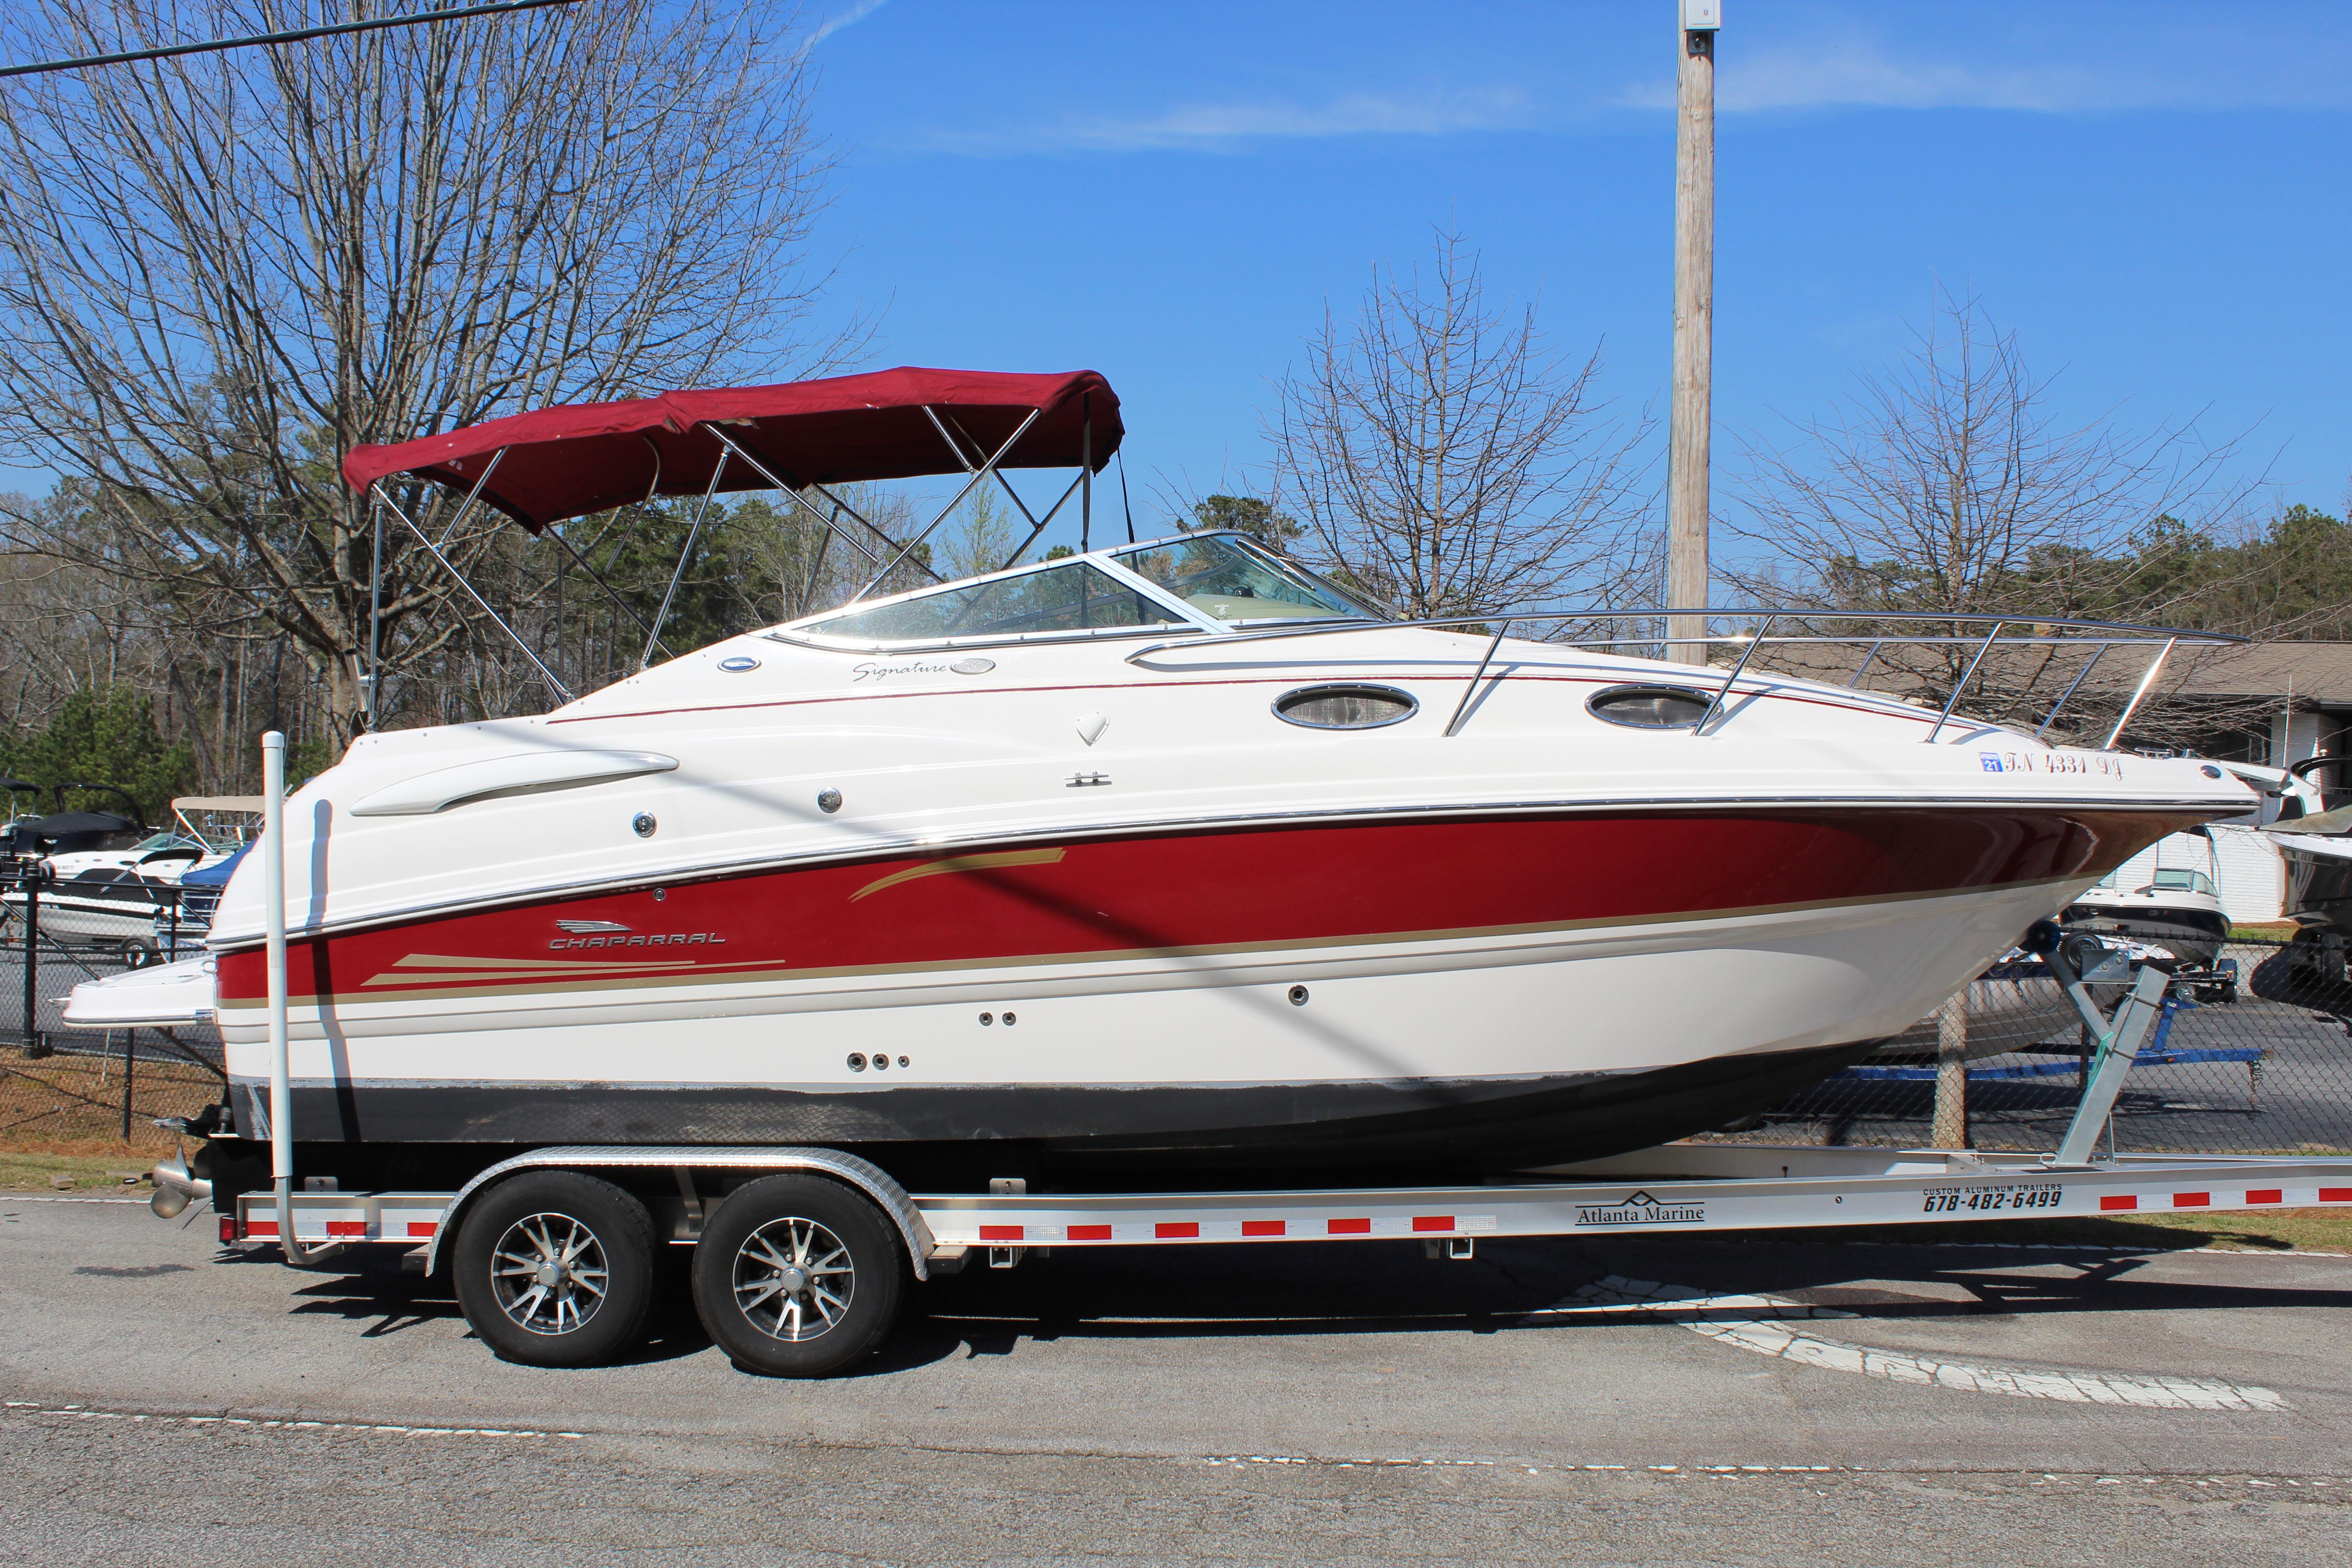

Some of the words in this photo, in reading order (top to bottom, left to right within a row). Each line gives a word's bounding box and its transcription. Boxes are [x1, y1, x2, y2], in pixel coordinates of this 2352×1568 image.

[853, 661, 947, 681] Signature
[961, 659, 984, 671] 260
[1984, 760, 1999, 771] 21
[2045, 755, 2087, 774] 4331
[549, 932, 726, 949] CHAPARRAL
[1923, 1187, 1960, 1196] CUSTOM
[1965, 1185, 2014, 1194] ALUMINUM
[2018, 1183, 2062, 1191] TRAILERS
[1923, 1191, 2062, 1212] 678-482-6499
[1577, 1208, 1639, 1223] Atlanta
[1645, 1206, 1704, 1220] Marine
